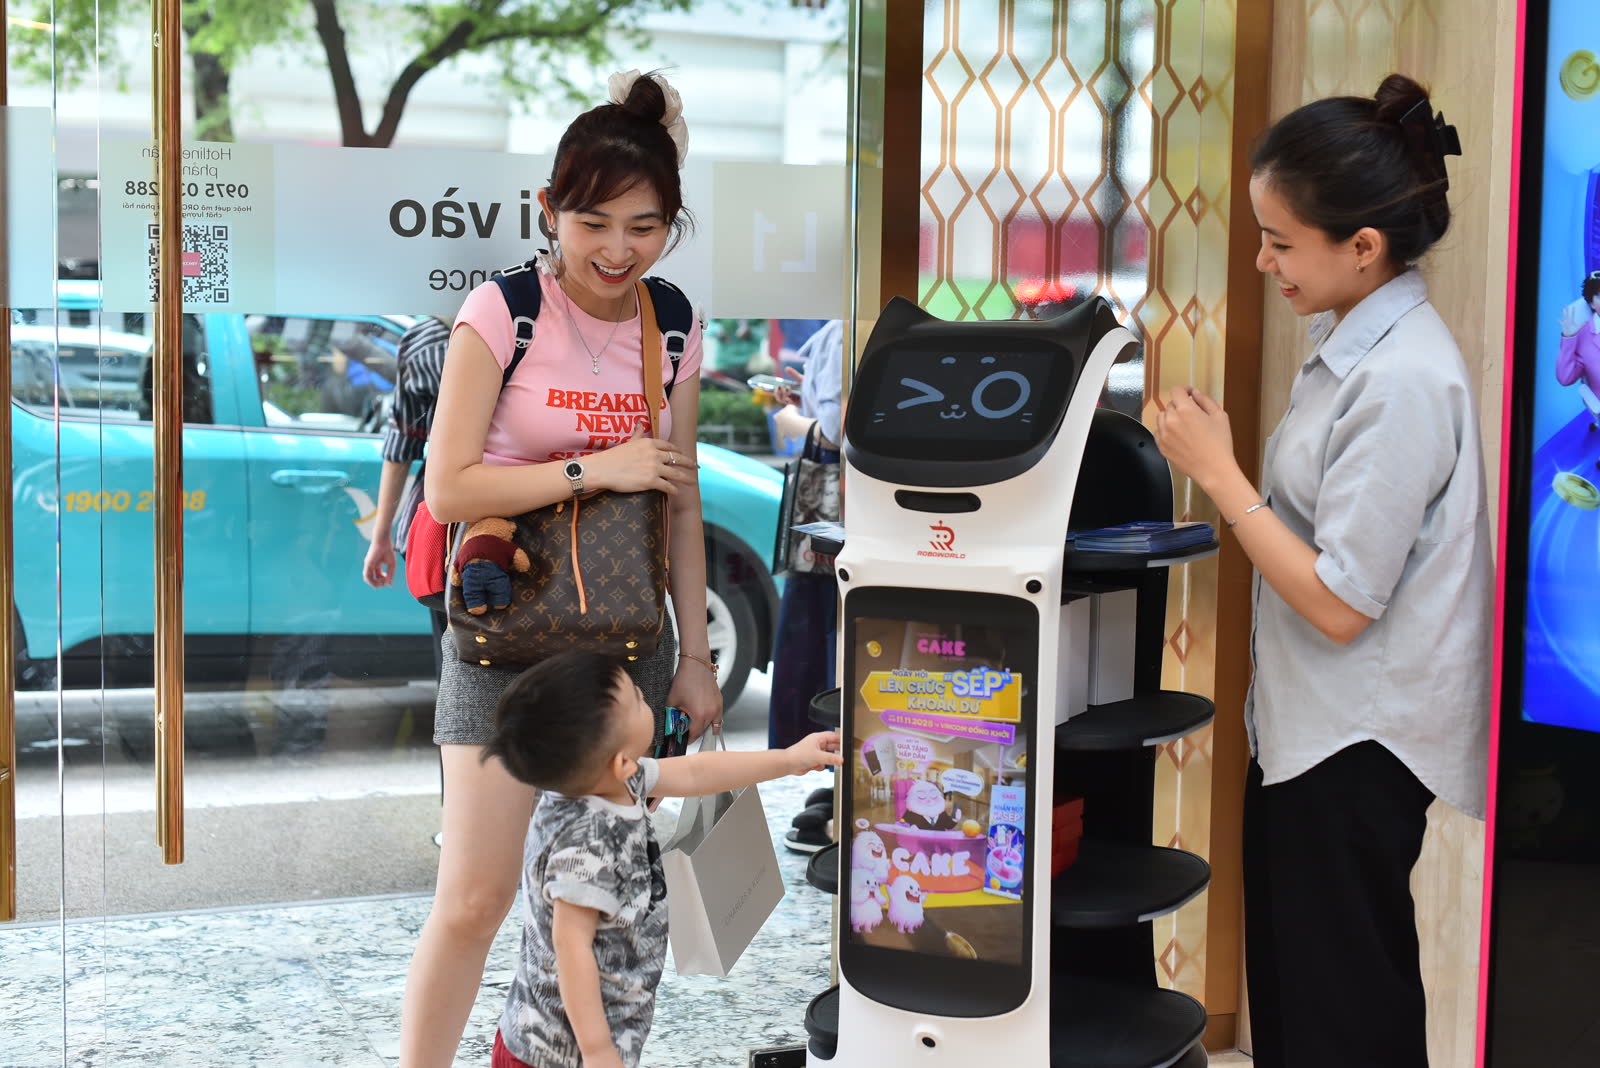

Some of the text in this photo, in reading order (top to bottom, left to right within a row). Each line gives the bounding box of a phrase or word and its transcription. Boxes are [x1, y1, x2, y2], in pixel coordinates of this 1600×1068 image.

[546, 388, 667, 412] BREAKI
[575, 412, 652, 434] NEWS
[64, 490, 131, 512] 1900
[916, 550, 967, 560] ROBOWORLD
[917, 638, 967, 657] CAKE
[878, 676, 905, 693] LÊN
[907, 677, 946, 695] CHỨC
[891, 847, 971, 877] CAKE
